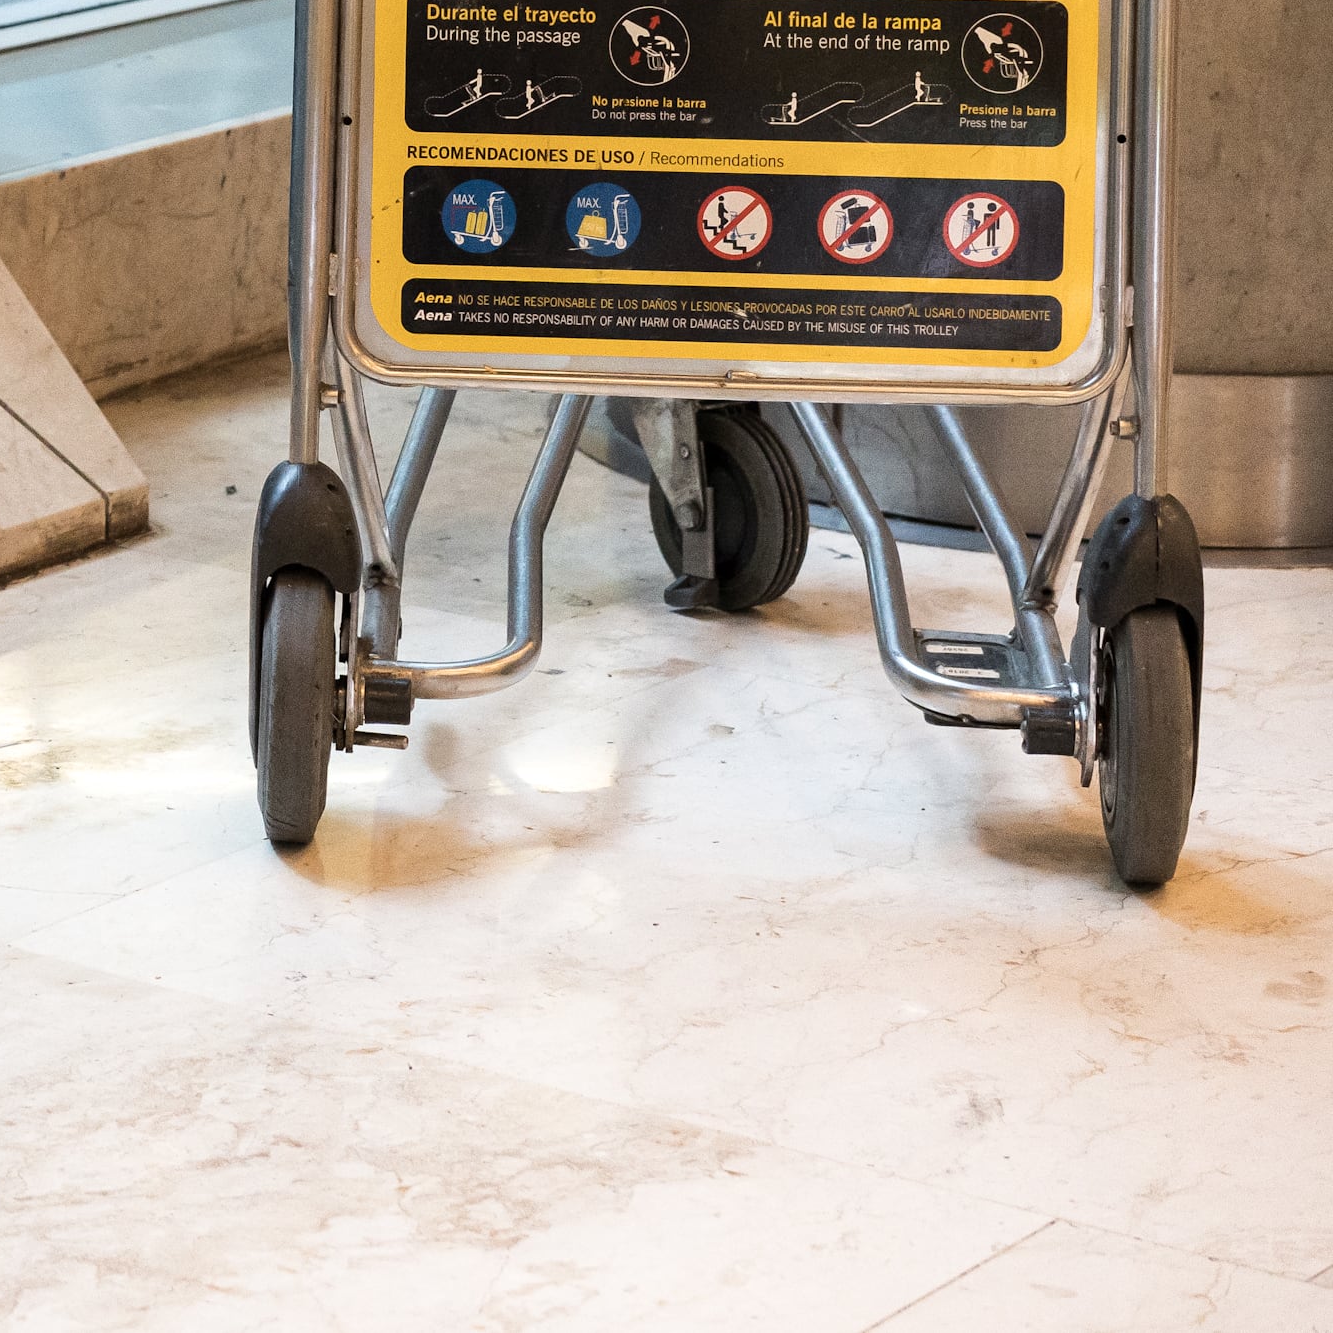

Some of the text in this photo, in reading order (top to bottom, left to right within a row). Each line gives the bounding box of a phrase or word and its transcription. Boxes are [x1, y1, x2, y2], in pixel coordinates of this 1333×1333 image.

[427, 4, 596, 26] Durante el trayecto
[764, 11, 941, 34] Al final de la rampa
[427, 25, 581, 46] During the passage
[763, 33, 949, 54] At the end of the ramp
[592, 96, 706, 110] No presione la barra
[960, 105, 1056, 117] Presione la barra
[592, 110, 696, 123] Do not press the bar
[960, 118, 1027, 128] Press the bar
[408, 146, 568, 162] RECOMENDACIONES
[575, 150, 595, 162] DE
[601, 150, 634, 164] USO
[651, 152, 784, 168] Recommendations
[453, 194, 477, 205] MAX.
[577, 198, 601, 208] MAX.
[414, 292, 1050, 320] Aena NO SE HACE RESPONSABLE DE LOS DAÑOS Y LESIONES PROVOCADAS POR ESTE CARRO AL USARLO INDEBIDAMENTE
[414, 309, 958, 336] Aena TAKES NO RESPONSABILITY OF ANY HARM OR DAMAGES CAUSED BY THE MISUSE OF THIS TROLLEY
